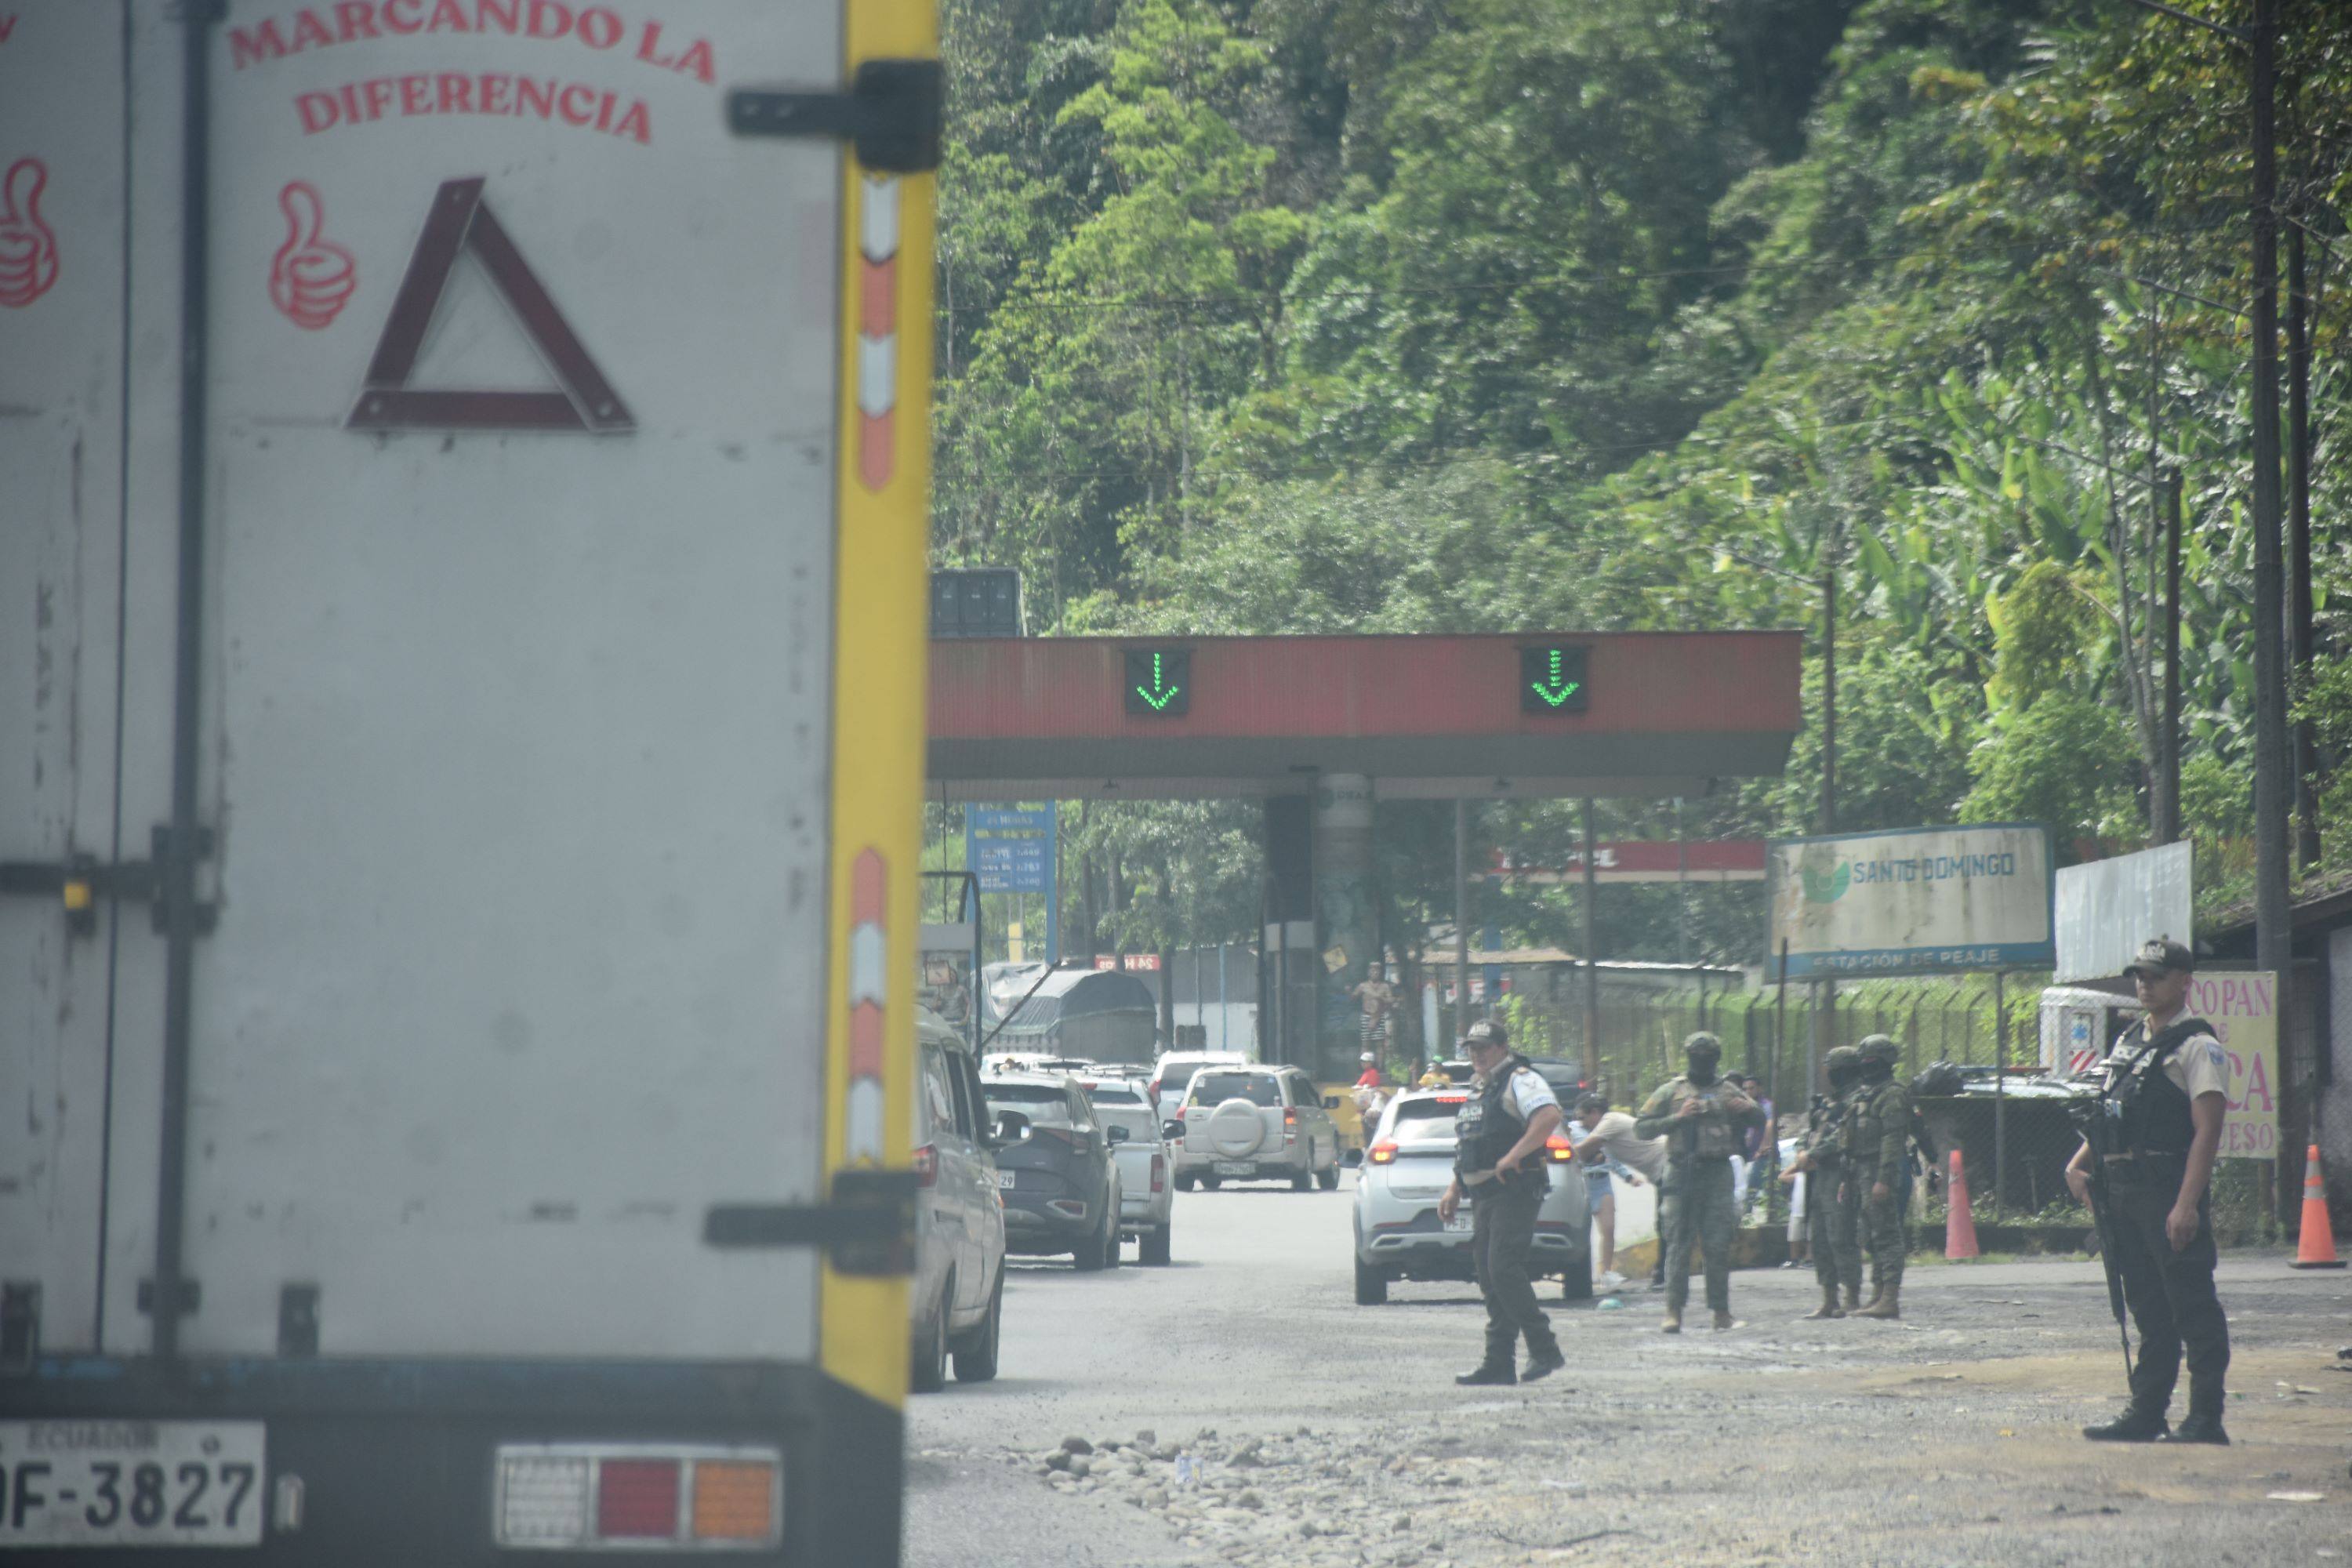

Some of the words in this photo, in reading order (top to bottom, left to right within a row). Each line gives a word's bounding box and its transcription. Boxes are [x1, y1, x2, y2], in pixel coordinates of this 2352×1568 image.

[227, 0, 625, 71] MARCANDO
[635, 20, 717, 85] LA
[293, 71, 652, 145] DIFERENCIA
[1853, 858, 1918, 884] SANTO
[1922, 853, 2014, 880] DOMINGO
[1910, 952, 1934, 966] DE
[1940, 948, 2001, 965] PEAJE
[27, 1421, 159, 1450] ECUADOR
